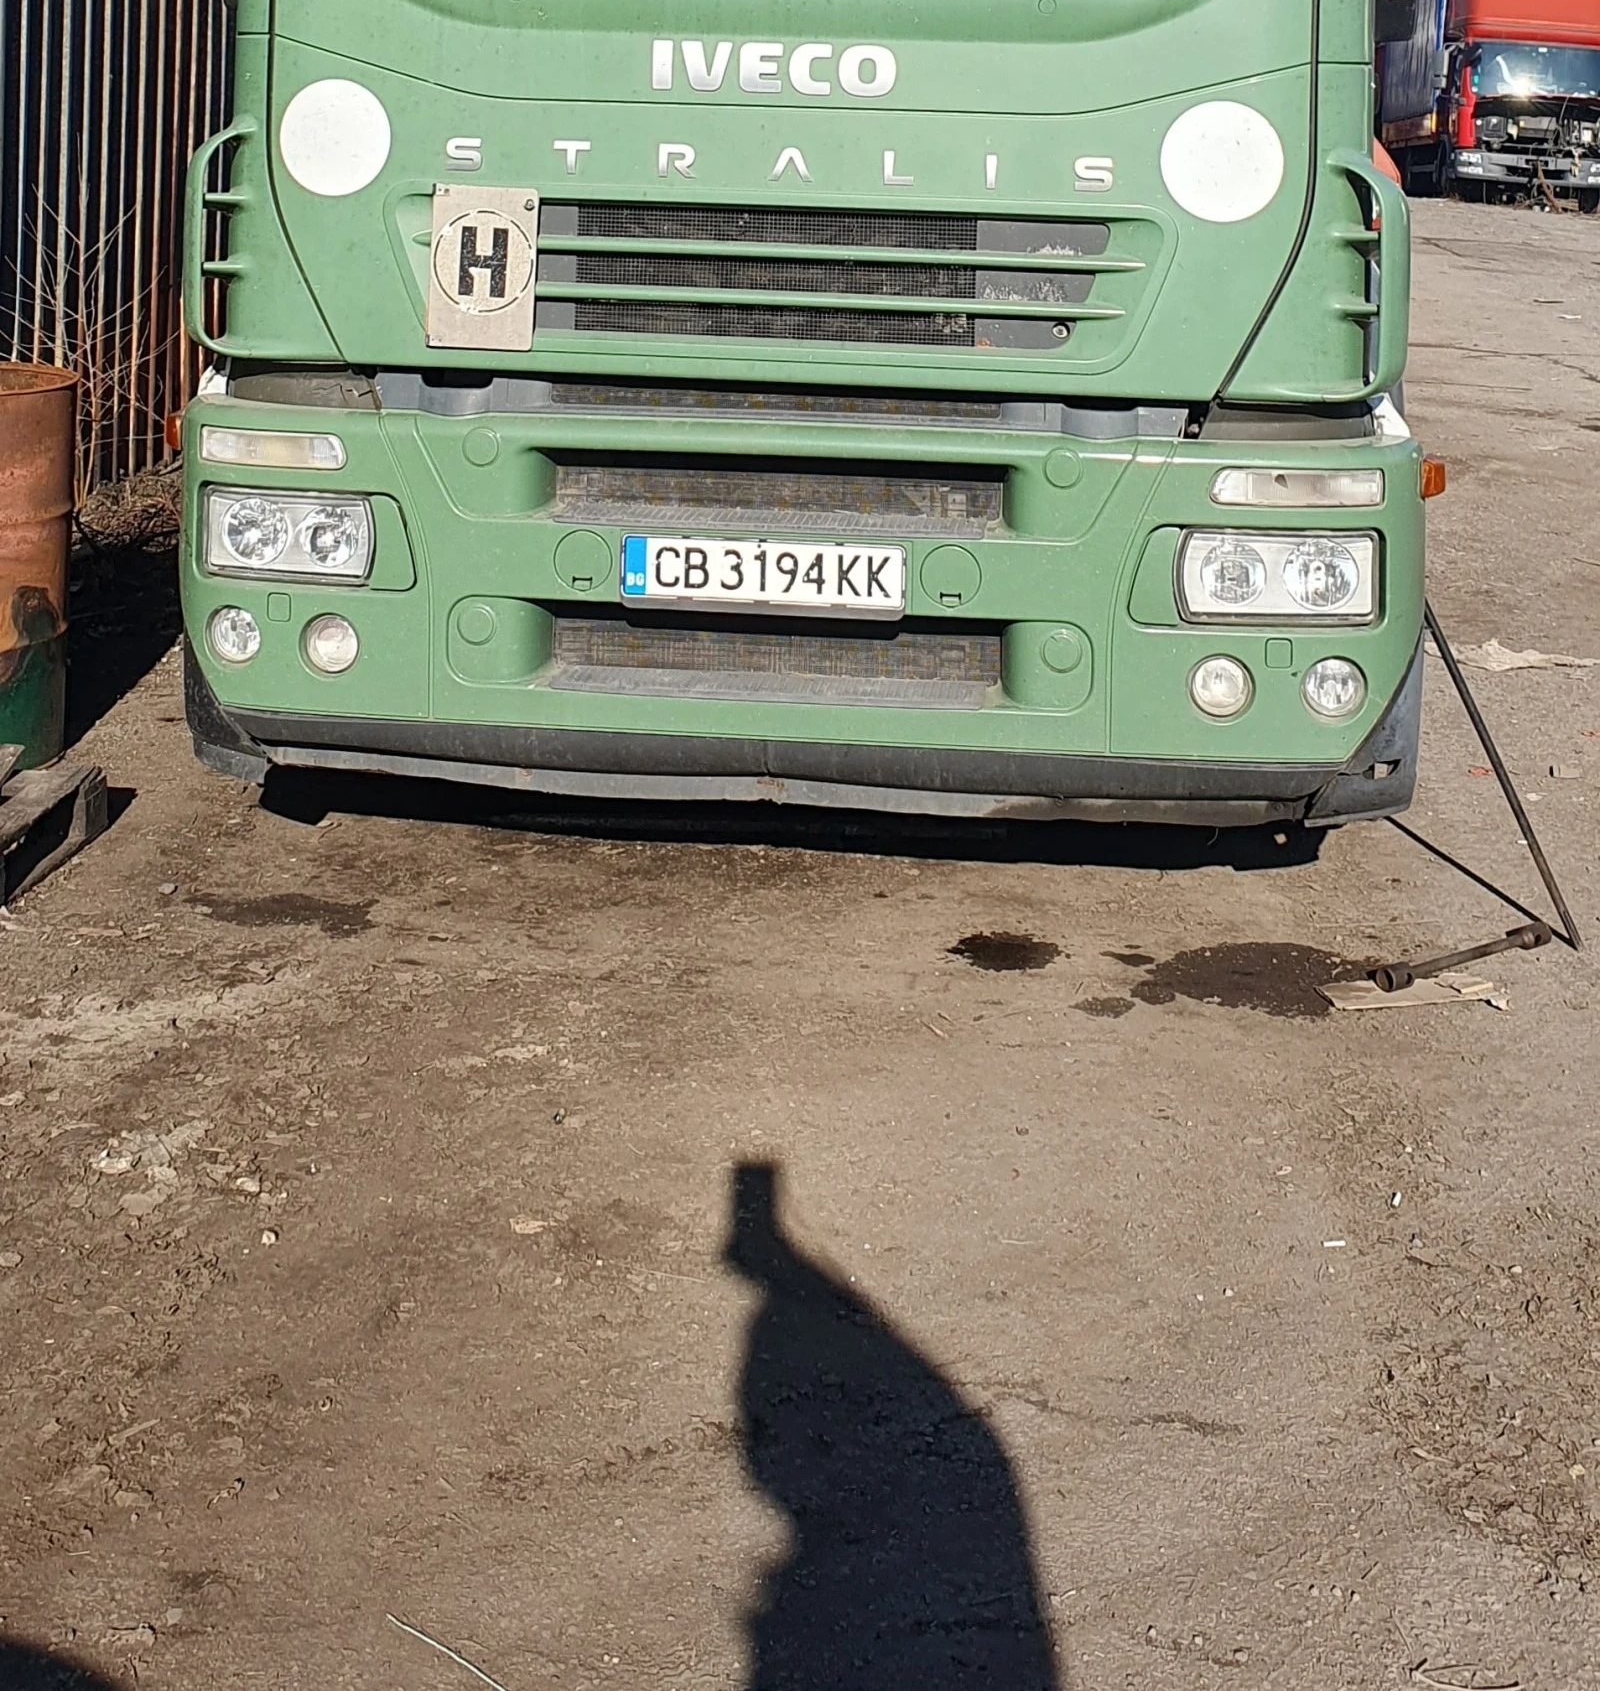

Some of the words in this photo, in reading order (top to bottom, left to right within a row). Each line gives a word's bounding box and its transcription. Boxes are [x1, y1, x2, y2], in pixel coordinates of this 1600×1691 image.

[650, 39, 898, 97] IVECO
[445, 137, 1114, 192] STRALIS
[458, 225, 509, 298] H
[626, 572, 645, 586] BG
